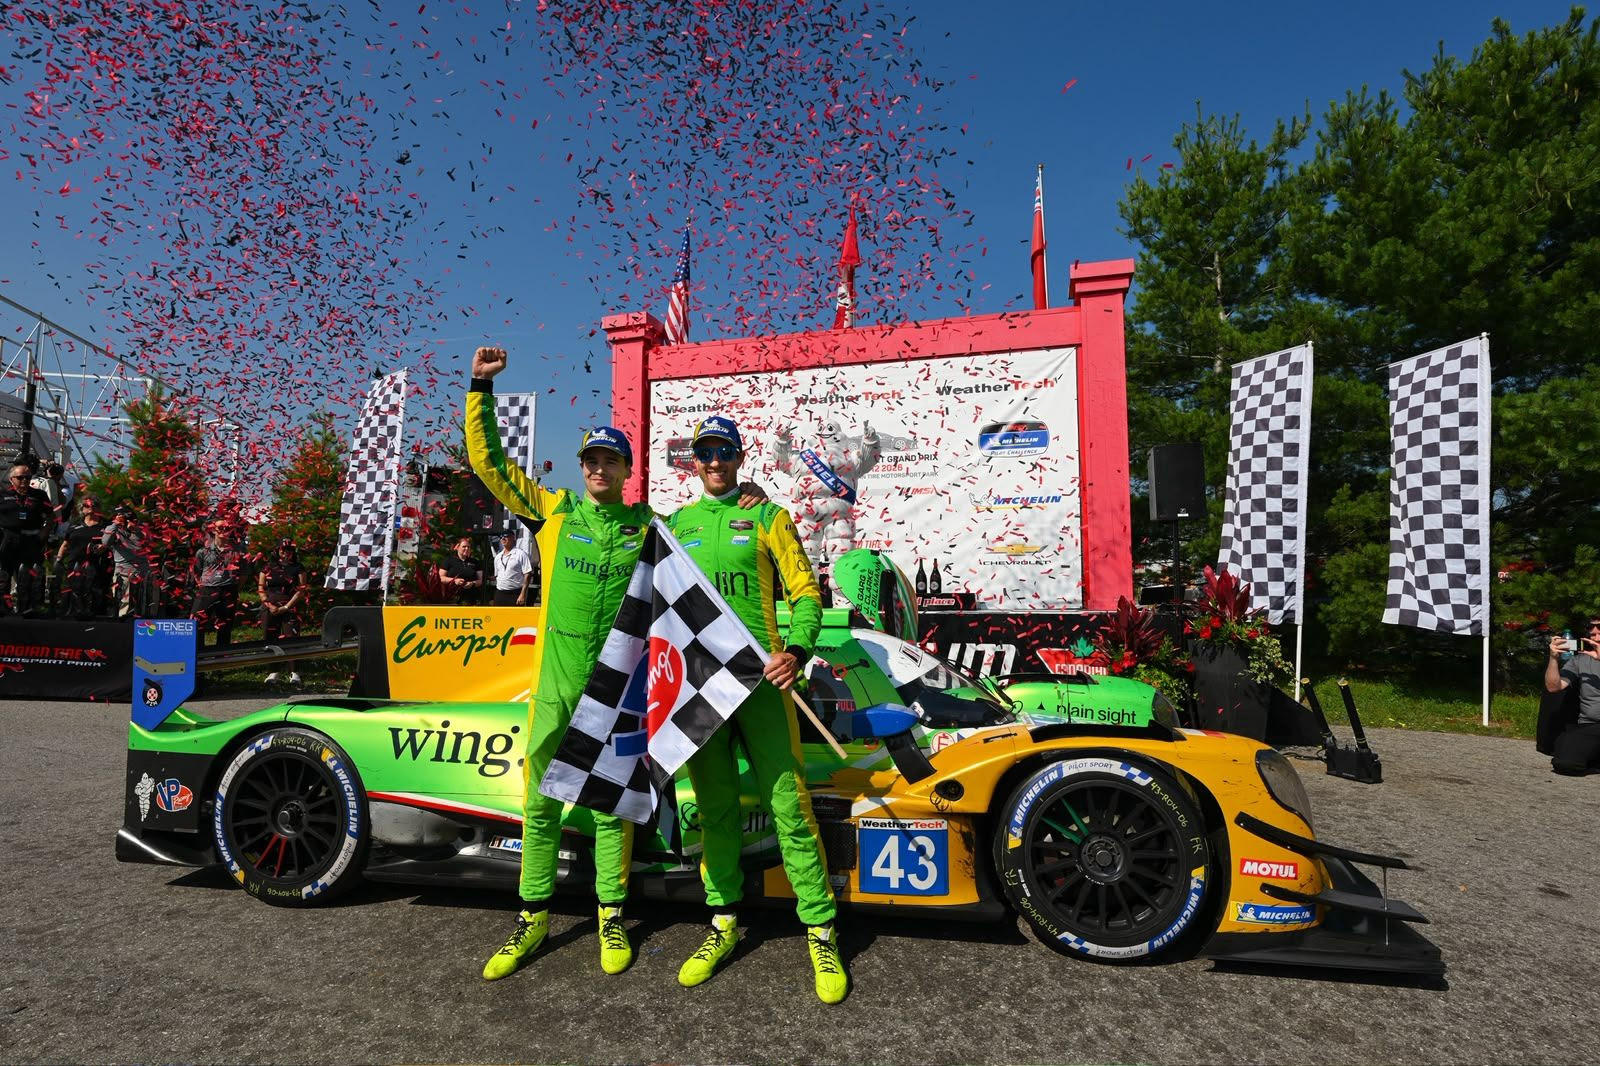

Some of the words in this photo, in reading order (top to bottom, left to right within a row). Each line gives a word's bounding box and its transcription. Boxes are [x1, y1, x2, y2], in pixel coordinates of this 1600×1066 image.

[936, 378, 1056, 396] WeatherTech
[665, 400, 764, 414] WeatherTec
[887, 454, 917, 463] GRAND
[922, 597, 955, 606] place
[157, 621, 193, 631] TENEG
[434, 618, 484, 630] INTER
[393, 616, 515, 667] Europol
[836, 700, 855, 712] PULL
[1097, 707, 1136, 726] sight
[1068, 762, 1087, 770] PILOT
[1089, 761, 1113, 769] SPORT
[335, 768, 358, 834] MICHELIN
[1014, 769, 1058, 825] MICHELIN
[214, 798, 232, 862] MICHELIN
[861, 820, 944, 829] WeatherTech
[872, 835, 938, 891] 43
[1242, 861, 1296, 878] MOTUL
[1153, 892, 1200, 949] MICHELIN
[1258, 911, 1311, 921] MICHELIN
